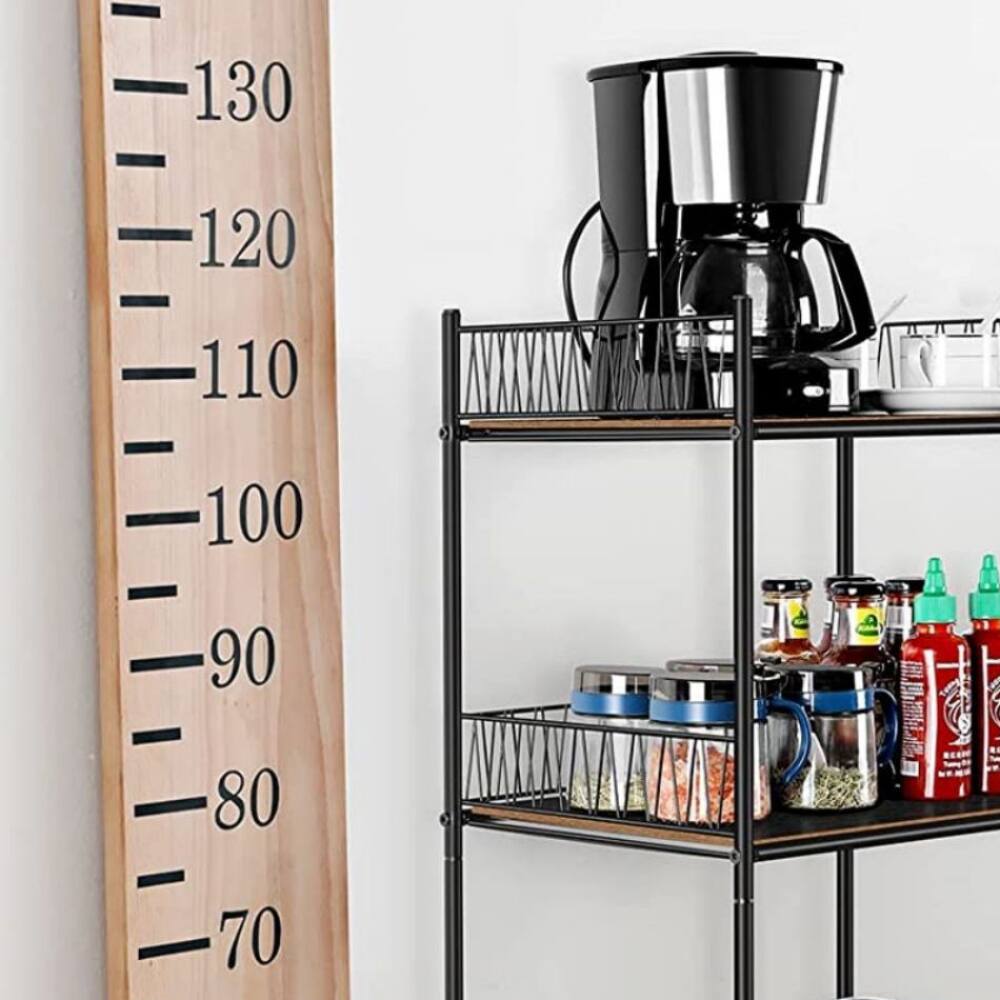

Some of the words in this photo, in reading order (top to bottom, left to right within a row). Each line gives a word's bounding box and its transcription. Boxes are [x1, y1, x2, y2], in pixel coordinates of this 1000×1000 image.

[194, 60, 292, 122] 130
[200, 208, 295, 269] 120
[203, 339, 298, 399] 110
[208, 480, 303, 546] 100
[211, 626, 275, 688] 90
[215, 767, 280, 830] 80
[219, 906, 282, 970] 70
